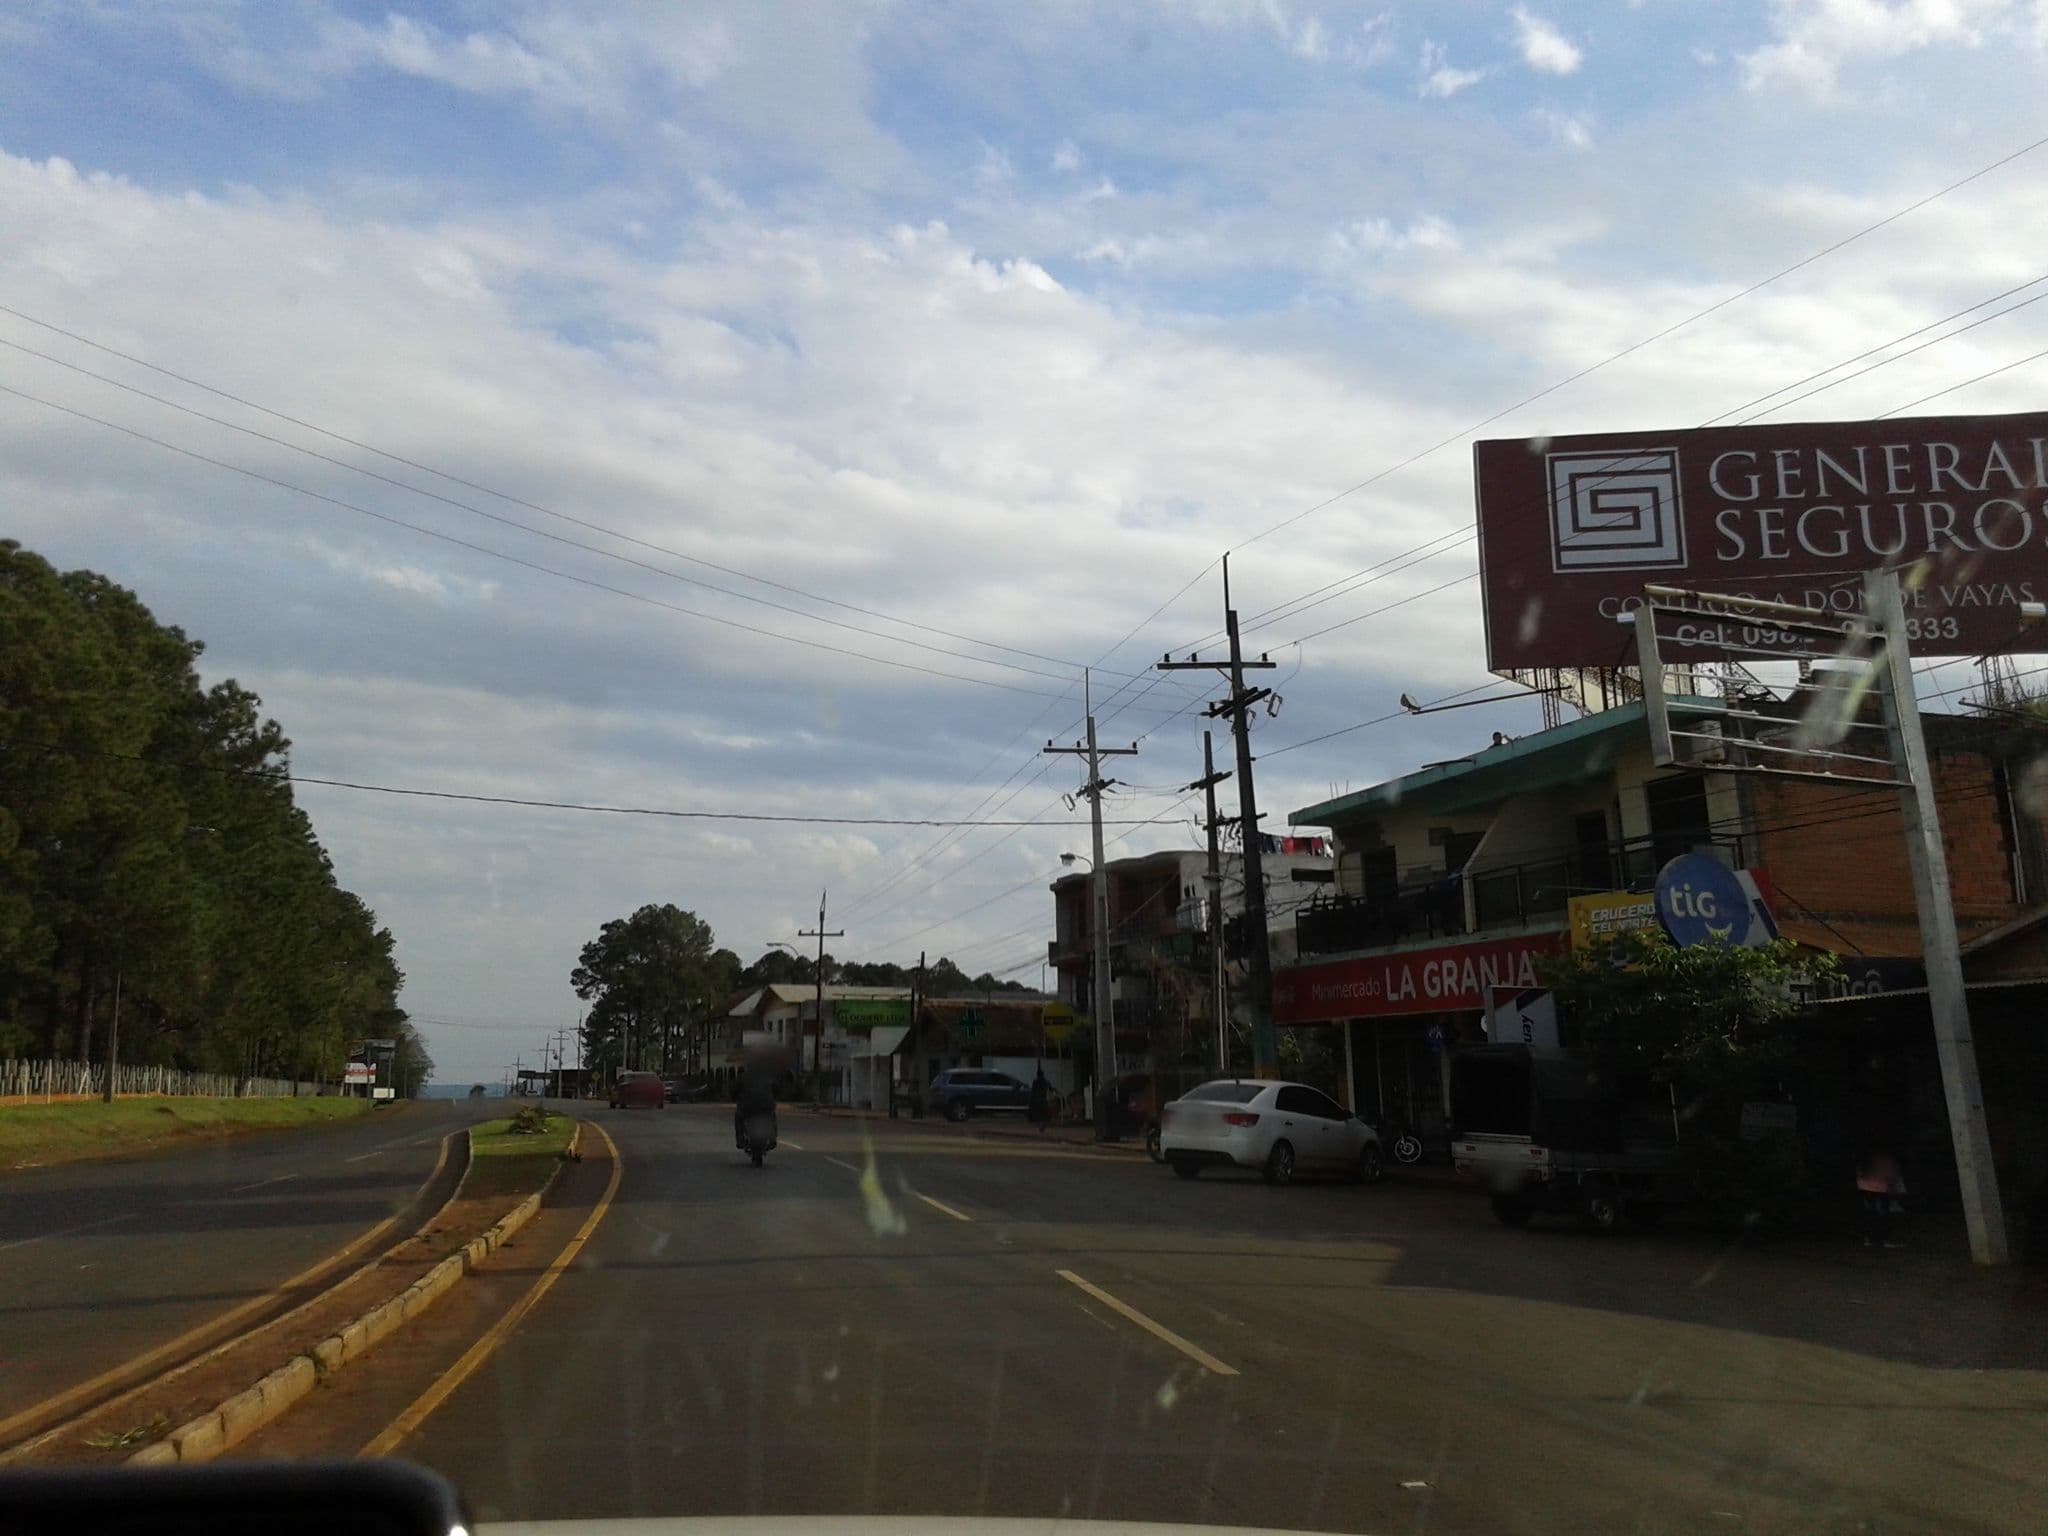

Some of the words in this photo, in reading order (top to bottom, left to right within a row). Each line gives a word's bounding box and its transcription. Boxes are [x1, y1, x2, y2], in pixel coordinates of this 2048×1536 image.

[1715, 498, 2047, 561] SEGURO
[1940, 582, 2035, 607] VAYAS
[1676, 623, 1732, 646] Cel:
[1312, 977, 1381, 1001] Minimercado
[1384, 965, 1417, 1002] LA
[1422, 949, 1537, 999] GRANJA
